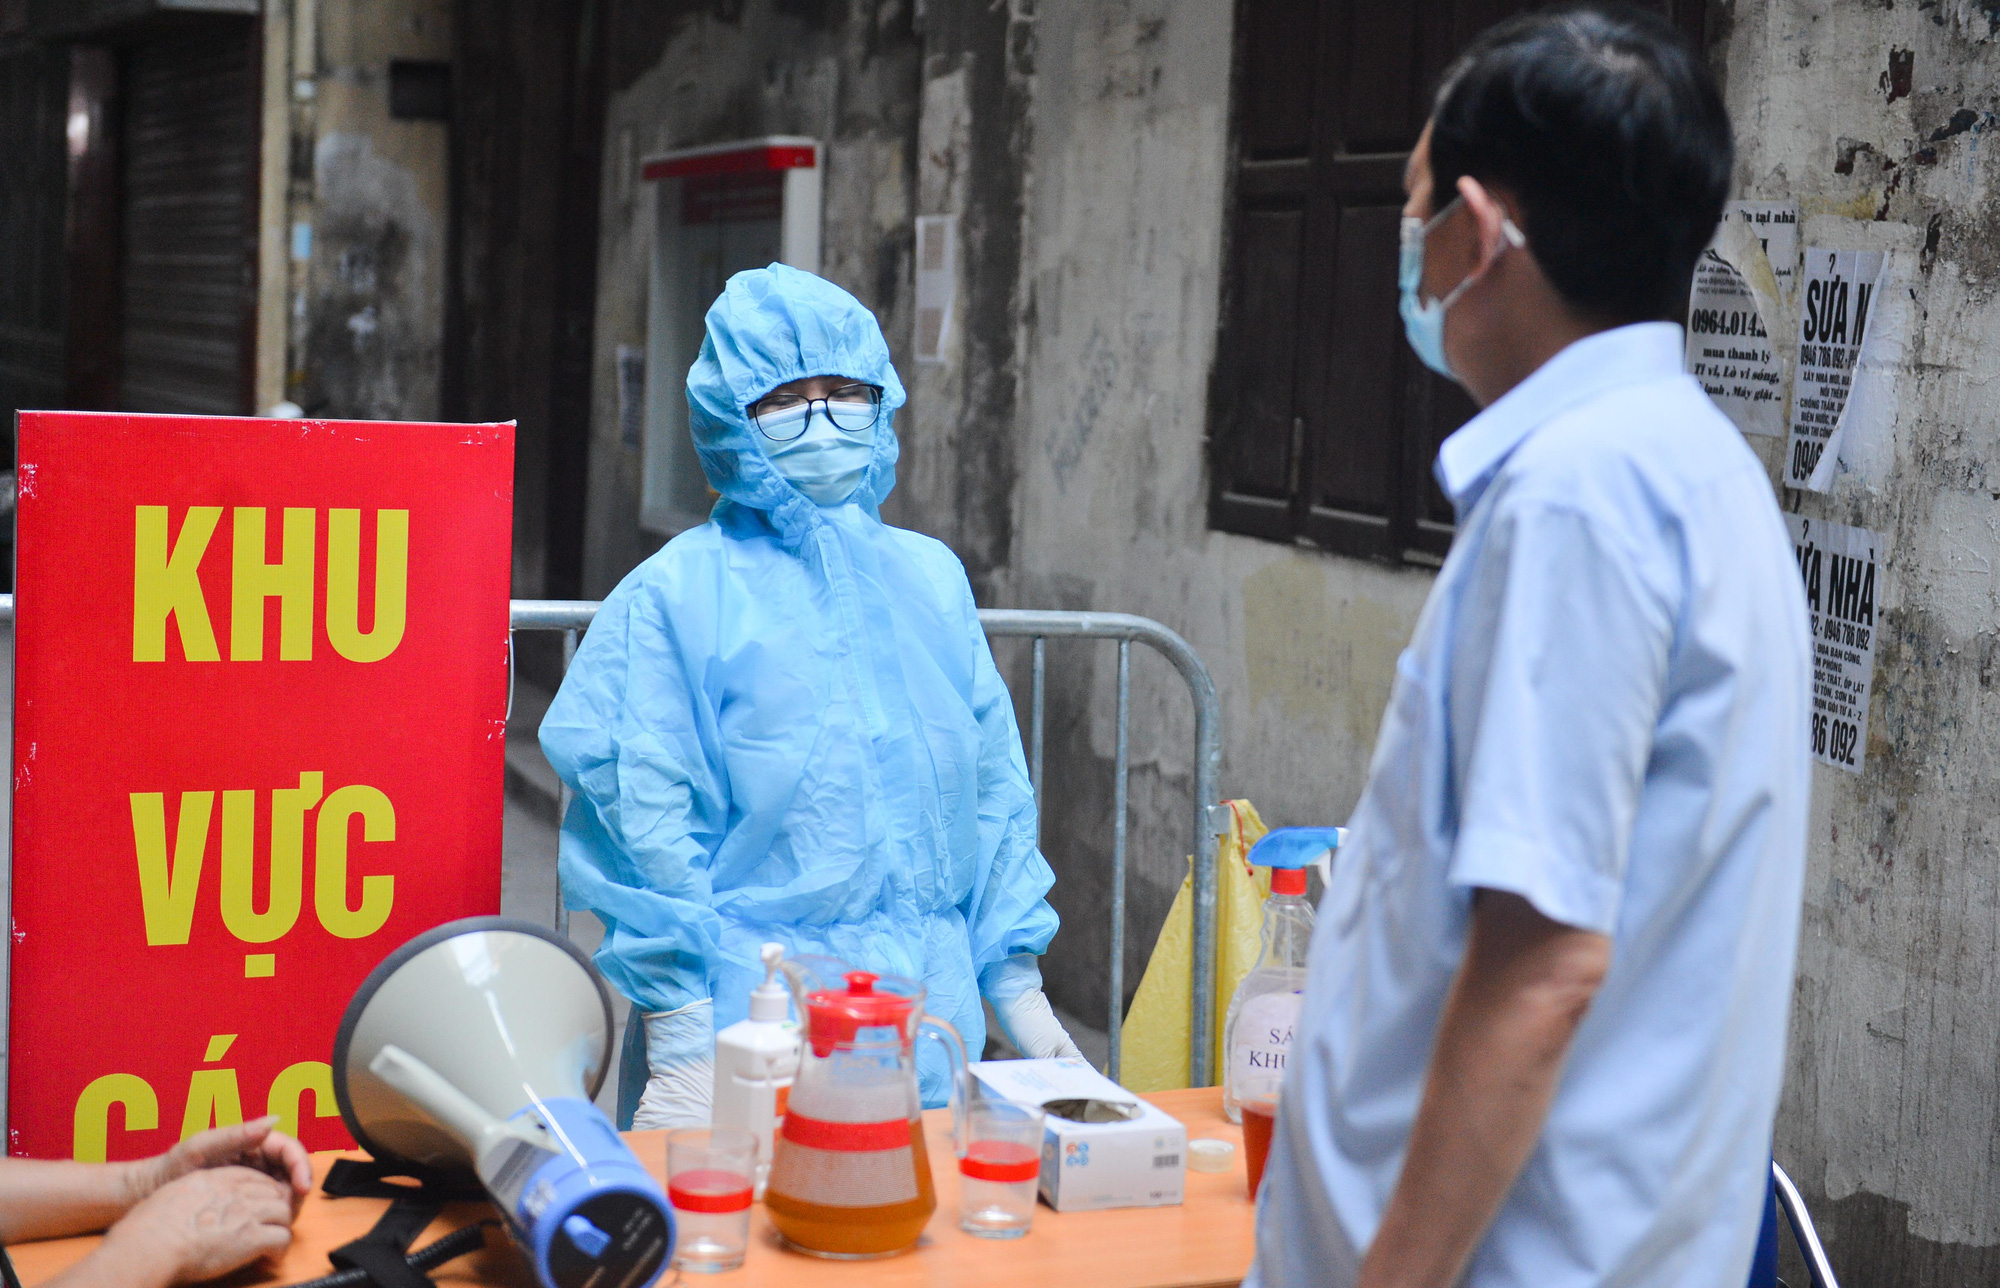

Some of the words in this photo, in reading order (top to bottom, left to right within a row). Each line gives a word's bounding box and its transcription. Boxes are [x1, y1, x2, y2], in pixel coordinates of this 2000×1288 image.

[1774, 209, 1795, 224] nhà
[1804, 253, 1849, 344] SỬA
[1703, 348, 1725, 358] mua
[1728, 347, 1758, 361] thanh
[1723, 365, 1737, 378] Lò
[1733, 385, 1753, 400] Máy
[133, 505, 409, 663] KHU
[1828, 547, 1875, 627] NHÀ
[1824, 618, 1841, 643] 0946
[1842, 622, 1855, 647] 786
[1856, 627, 1870, 651] 092
[1857, 711, 1862, 721] Z
[1830, 719, 1857, 766] 092
[129, 771, 396, 978] VỰC
